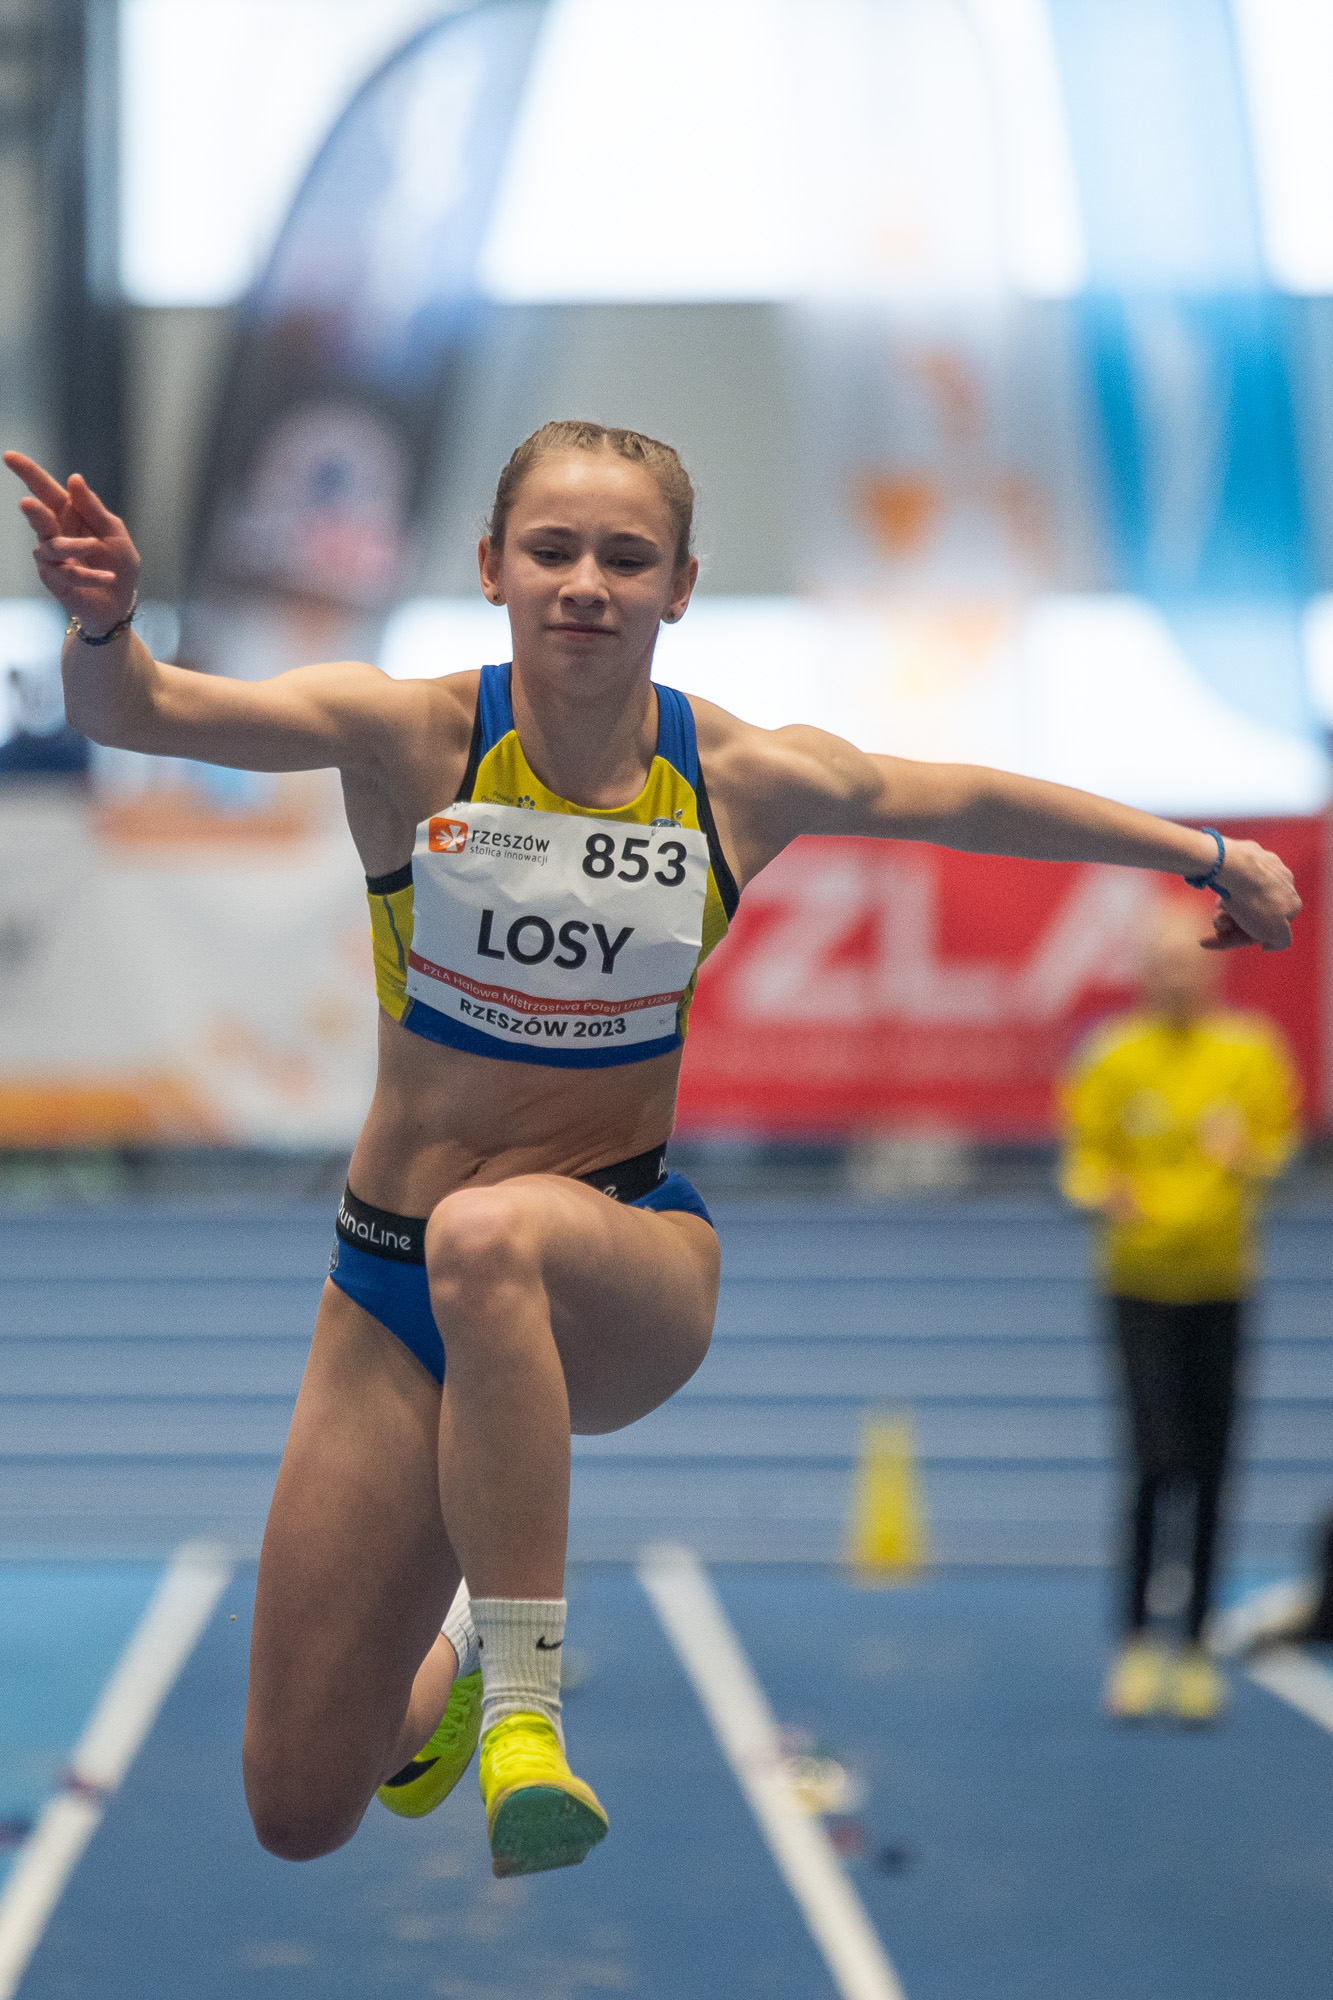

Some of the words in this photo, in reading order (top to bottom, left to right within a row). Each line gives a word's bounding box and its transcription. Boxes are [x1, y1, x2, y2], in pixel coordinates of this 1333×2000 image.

[470, 845, 501, 858] stolica
[504, 849, 548, 867] innowacji
[471, 829, 550, 853] rzeszów
[582, 833, 687, 887] 853
[476, 909, 635, 975] LOSY
[423, 963, 451, 981] PZLA
[453, 976, 499, 1000] Halowe
[502, 992, 580, 1013] Mistrzostwa
[583, 1002, 621, 1014] Polski
[460, 998, 568, 1038] RZESZÓW
[573, 1017, 627, 1038] 2023
